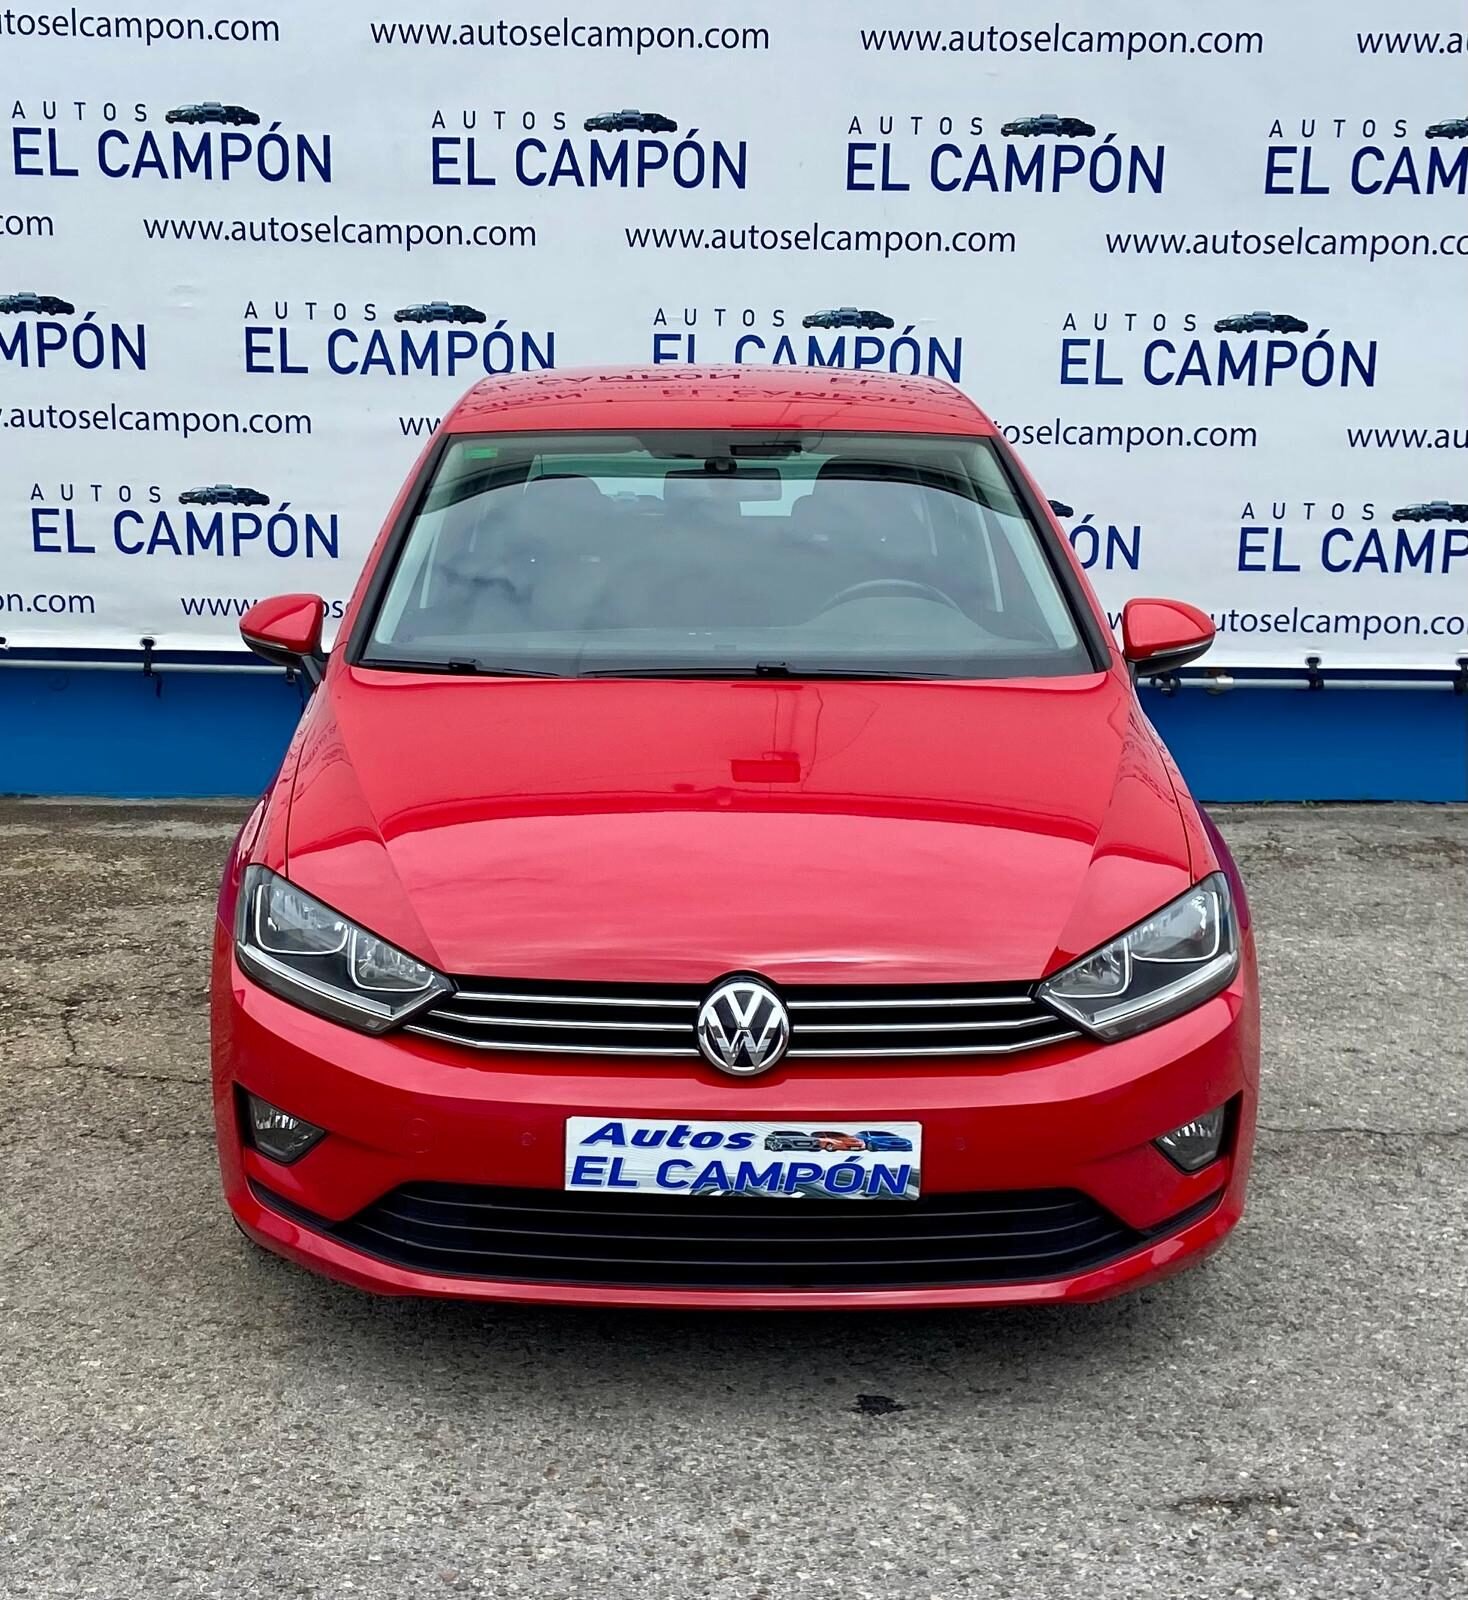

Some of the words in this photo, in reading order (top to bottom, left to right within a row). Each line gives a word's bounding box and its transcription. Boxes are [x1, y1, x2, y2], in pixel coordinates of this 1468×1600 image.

[371, 17, 769, 55] www.autoselcampon.com
[861, 23, 1263, 60] www.autoselcampon.com
[1357, 32, 1468, 54] www.a
[12, 101, 146, 122] AUTOS
[432, 110, 565, 130] AUTOS
[848, 116, 983, 136] AUTOS
[1269, 120, 1407, 139] AUTOS
[13, 127, 78, 176] EL
[98, 122, 332, 182] CAMPÓN
[432, 137, 496, 186] EL
[516, 129, 747, 189] CAMPÓN
[847, 143, 911, 191] EL
[931, 133, 1165, 194] CAMPÓN
[1265, 146, 1330, 194] EL
[143, 215, 536, 251] www.autoselcampon.com
[625, 223, 1016, 258] www.autoselcampon.com
[244, 301, 377, 321] AUTOS
[654, 308, 785, 327] AUTOS
[1063, 313, 1197, 332] AUTOS
[245, 327, 309, 373] EL
[328, 320, 555, 376] CAMPÓN
[735, 325, 963, 384] CAMPÓN
[1061, 339, 1124, 386] EL
[1144, 330, 1378, 387] CAMPÓN
[0, 403, 312, 438] .autoselcampon.com
[31, 484, 161, 503] AUTOS
[1241, 502, 1375, 521] AUTOS
[32, 508, 96, 553] EL
[114, 503, 339, 558] CAMPÓN
[1238, 527, 1301, 573] EL
[0, 593, 95, 613] n.com
[579, 1121, 756, 1150] Autos
[570, 1155, 638, 1187] EL
[655, 1155, 911, 1195] CAMPÓN
